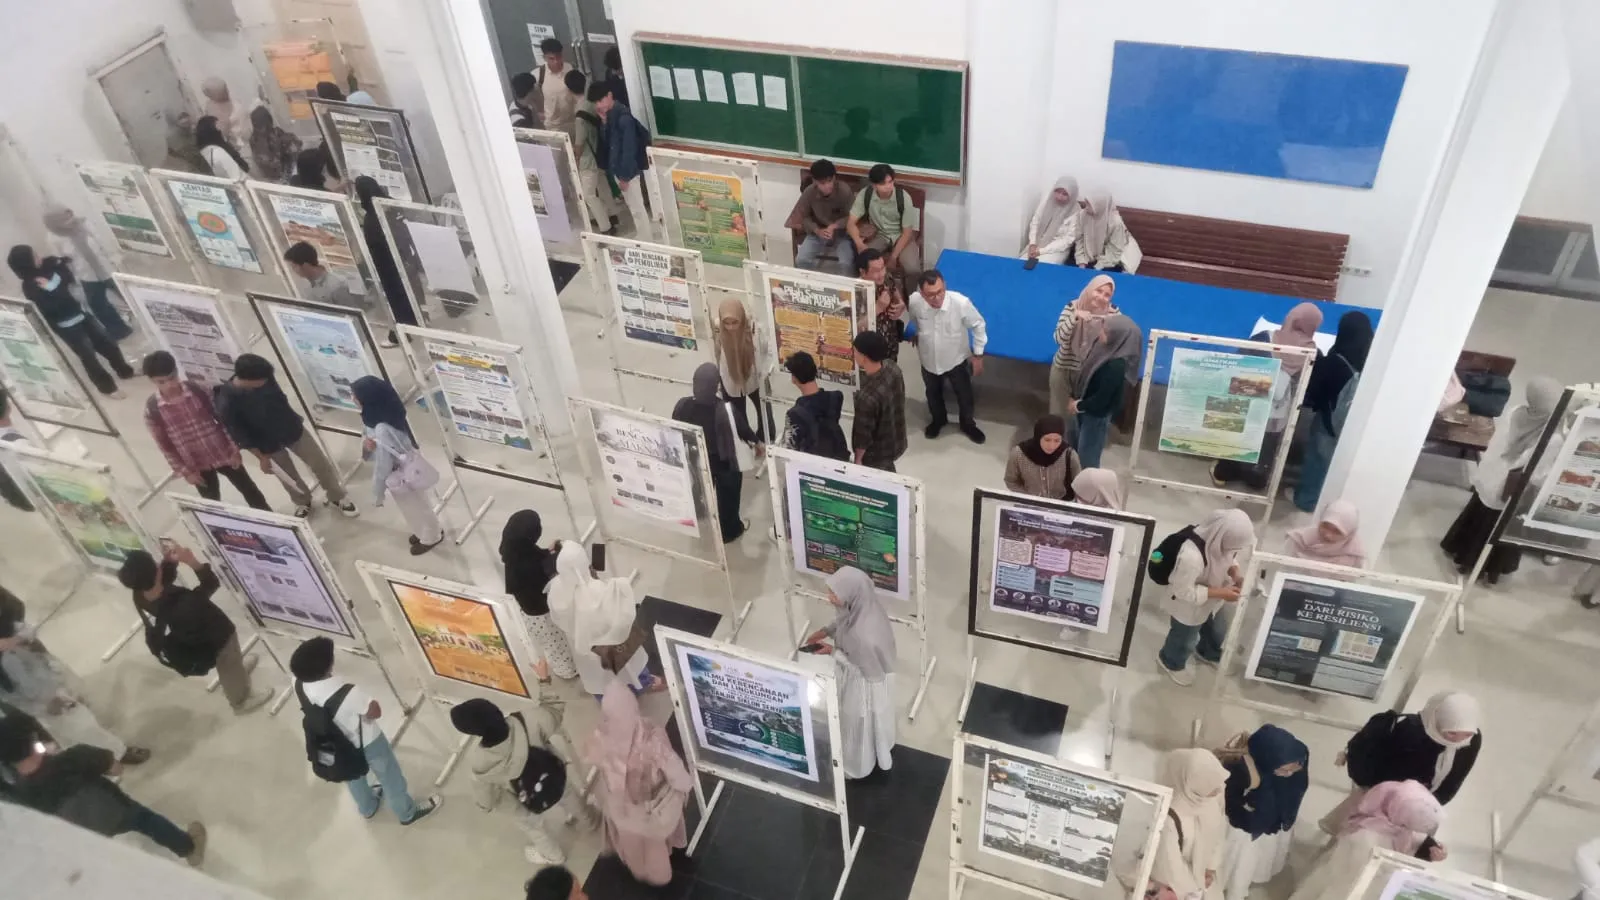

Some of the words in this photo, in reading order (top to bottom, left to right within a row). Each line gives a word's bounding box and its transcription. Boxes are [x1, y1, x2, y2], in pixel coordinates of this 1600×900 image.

[1296, 610, 1314, 619] KE
[1315, 614, 1382, 632] RESILIENSI
[1303, 603, 1335, 615] DARI
[1337, 609, 1380, 624] RISIKO
[703, 671, 724, 682] ILMU
[731, 684, 783, 704] LINGKUNGAN
